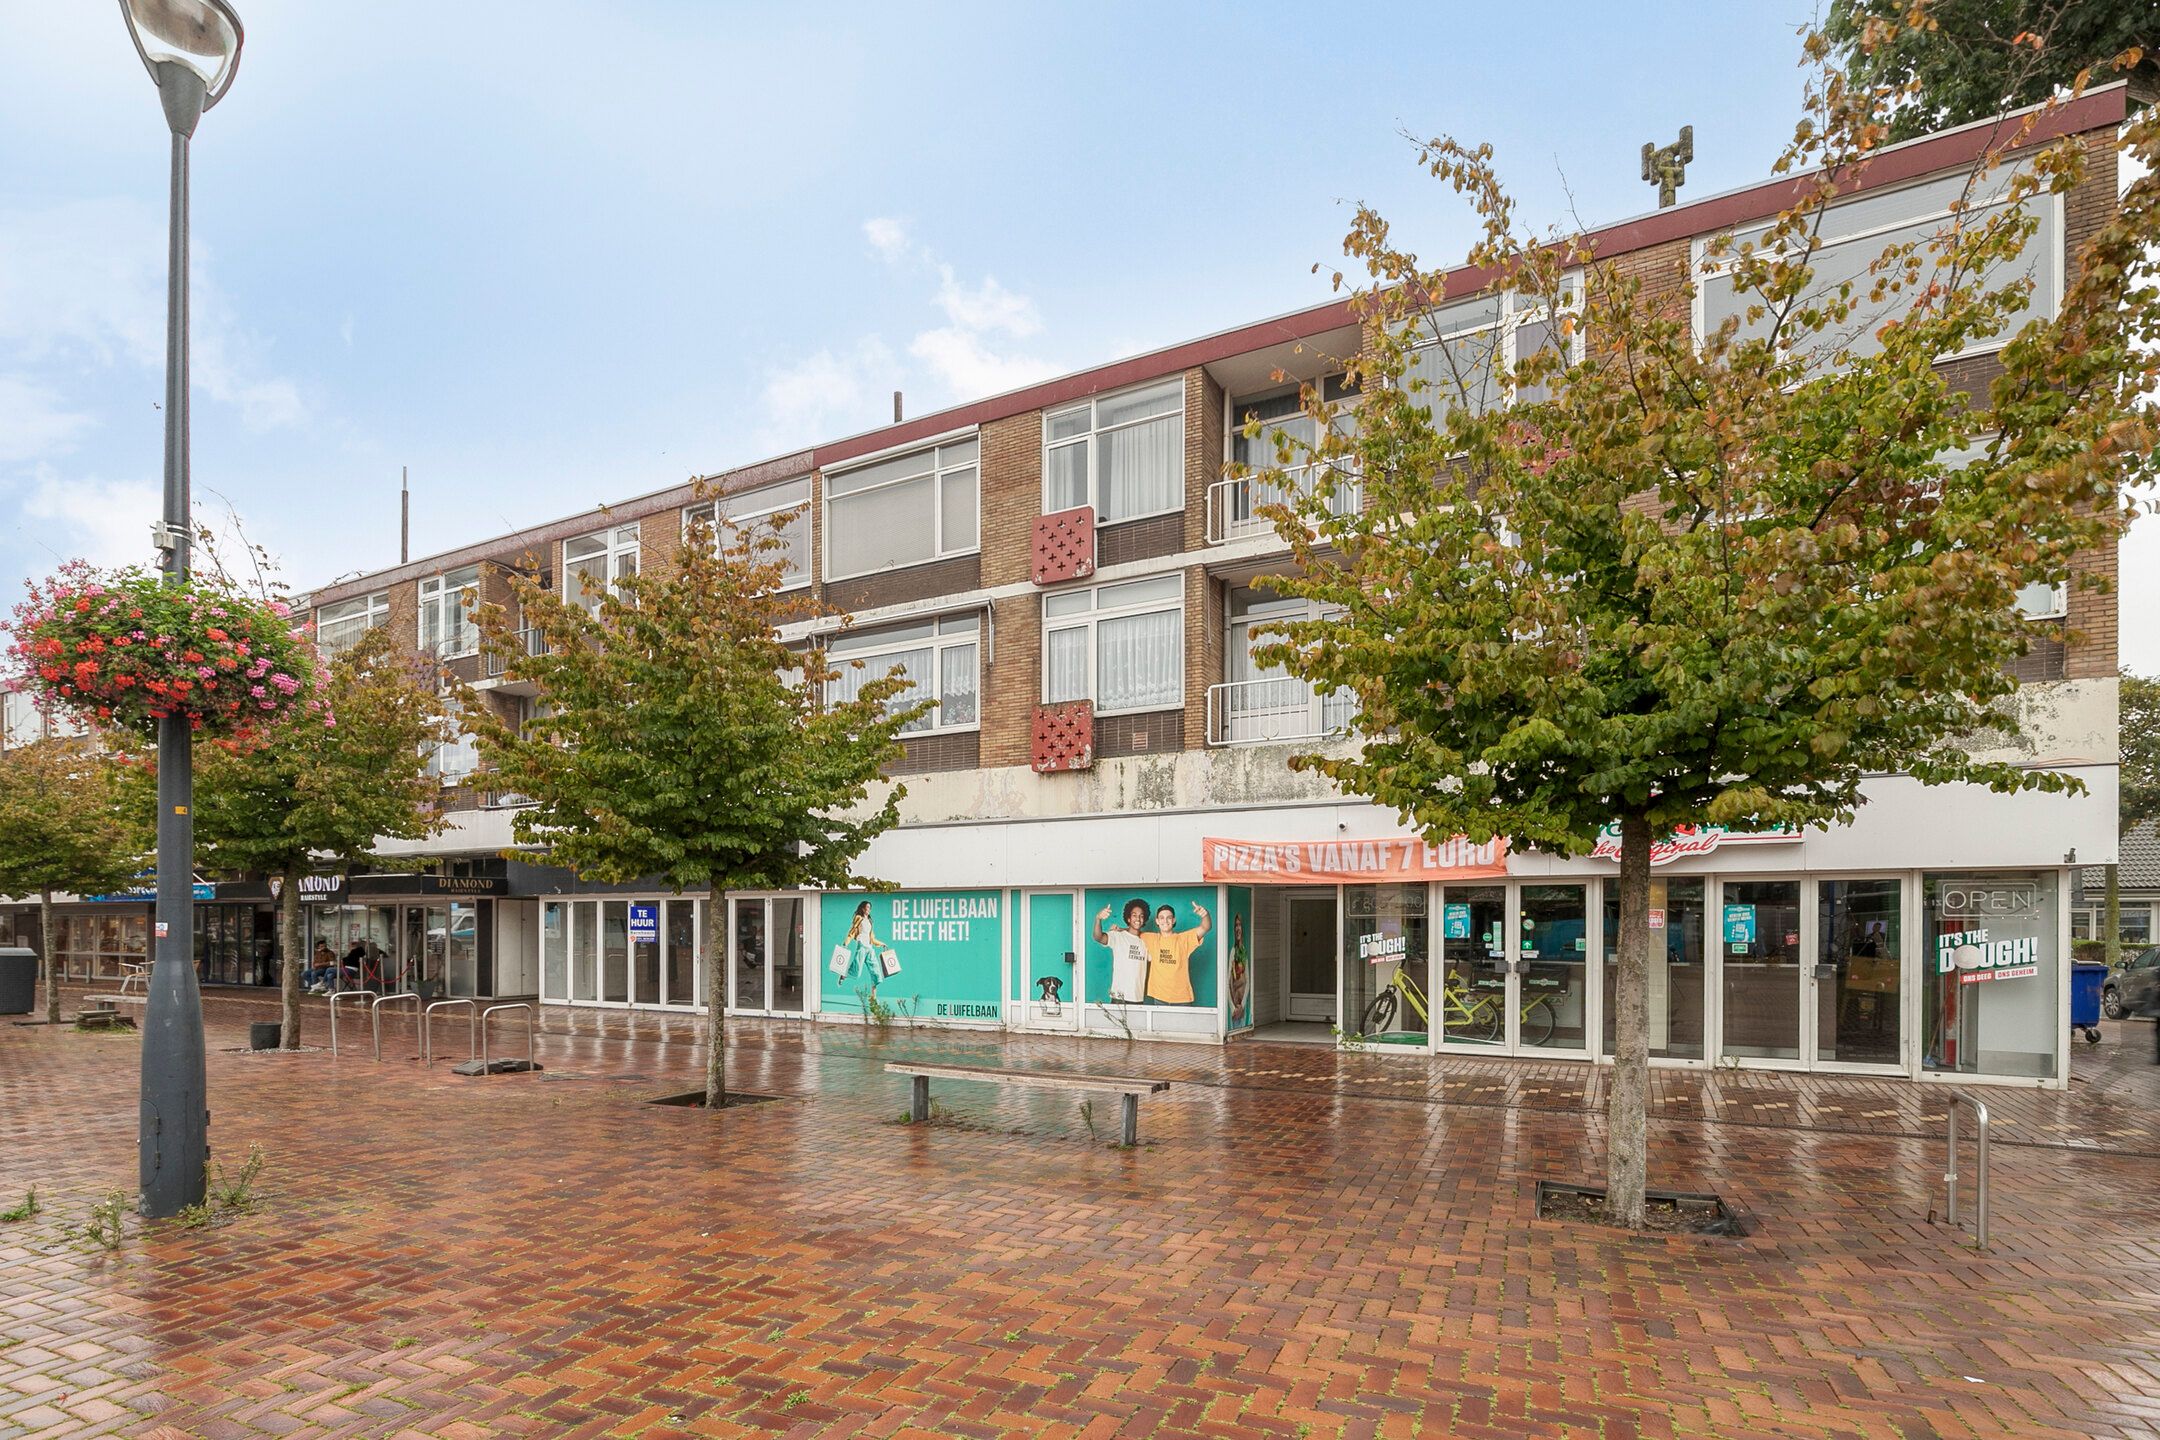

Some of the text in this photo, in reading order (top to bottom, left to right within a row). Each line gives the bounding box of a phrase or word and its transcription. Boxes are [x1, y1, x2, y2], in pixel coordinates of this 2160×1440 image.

[1214, 838, 1495, 872] PIZZA'S VANAF 7 EURO
[439, 878, 493, 889] DIAMOND
[892, 897, 997, 919] DE LUIFELBAAN
[1945, 890, 2030, 909] OPEN
[637, 909, 648, 918] TE
[631, 918, 654, 927] HUUR
[892, 920, 970, 941] HEEFT HET!
[1372, 932, 1383, 941] THE
[1939, 928, 1989, 948] IT'S THE
[937, 1003, 998, 1018] DE LUIFELBAAN
